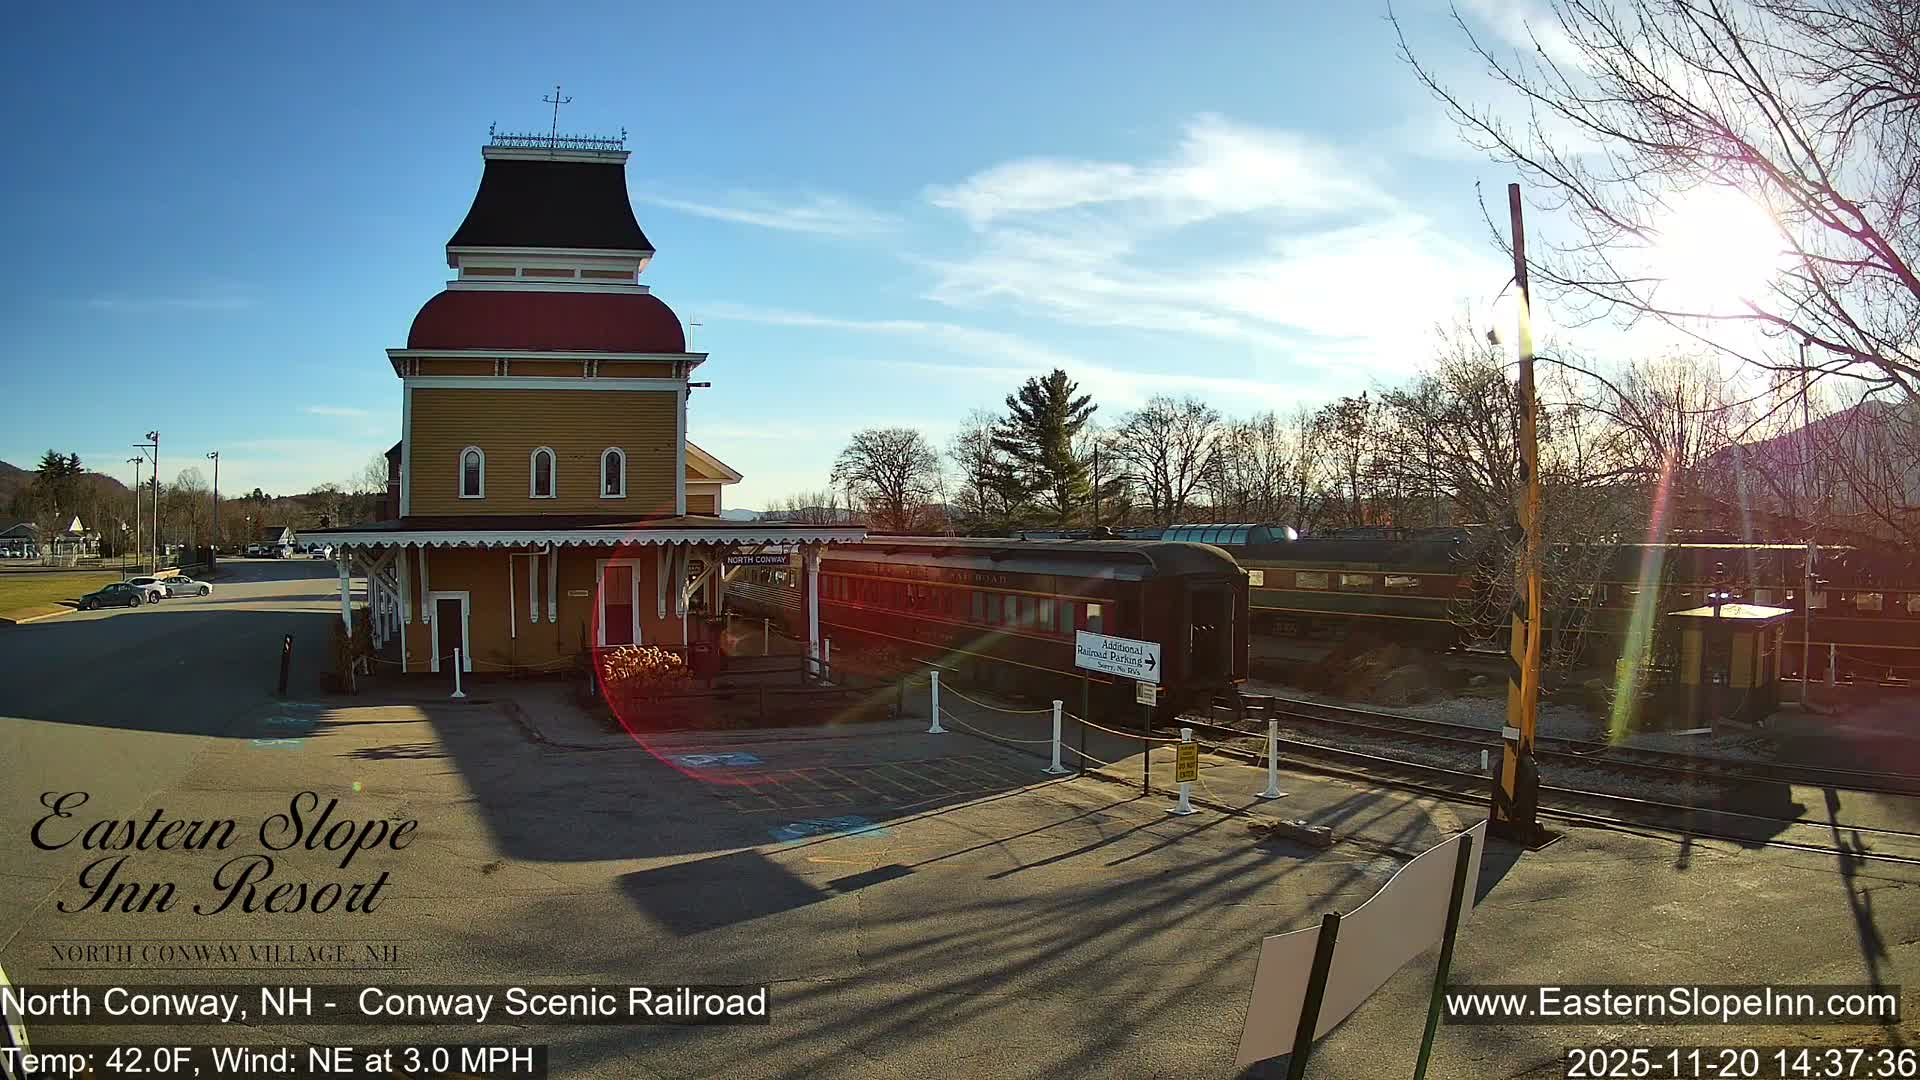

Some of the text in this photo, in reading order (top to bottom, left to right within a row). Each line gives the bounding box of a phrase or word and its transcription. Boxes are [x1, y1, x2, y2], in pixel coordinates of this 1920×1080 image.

[727, 556, 786, 564] NORTH CONWAY
[1102, 640, 1143, 656] Additional
[1077, 645, 1143, 668] Railroad Parking
